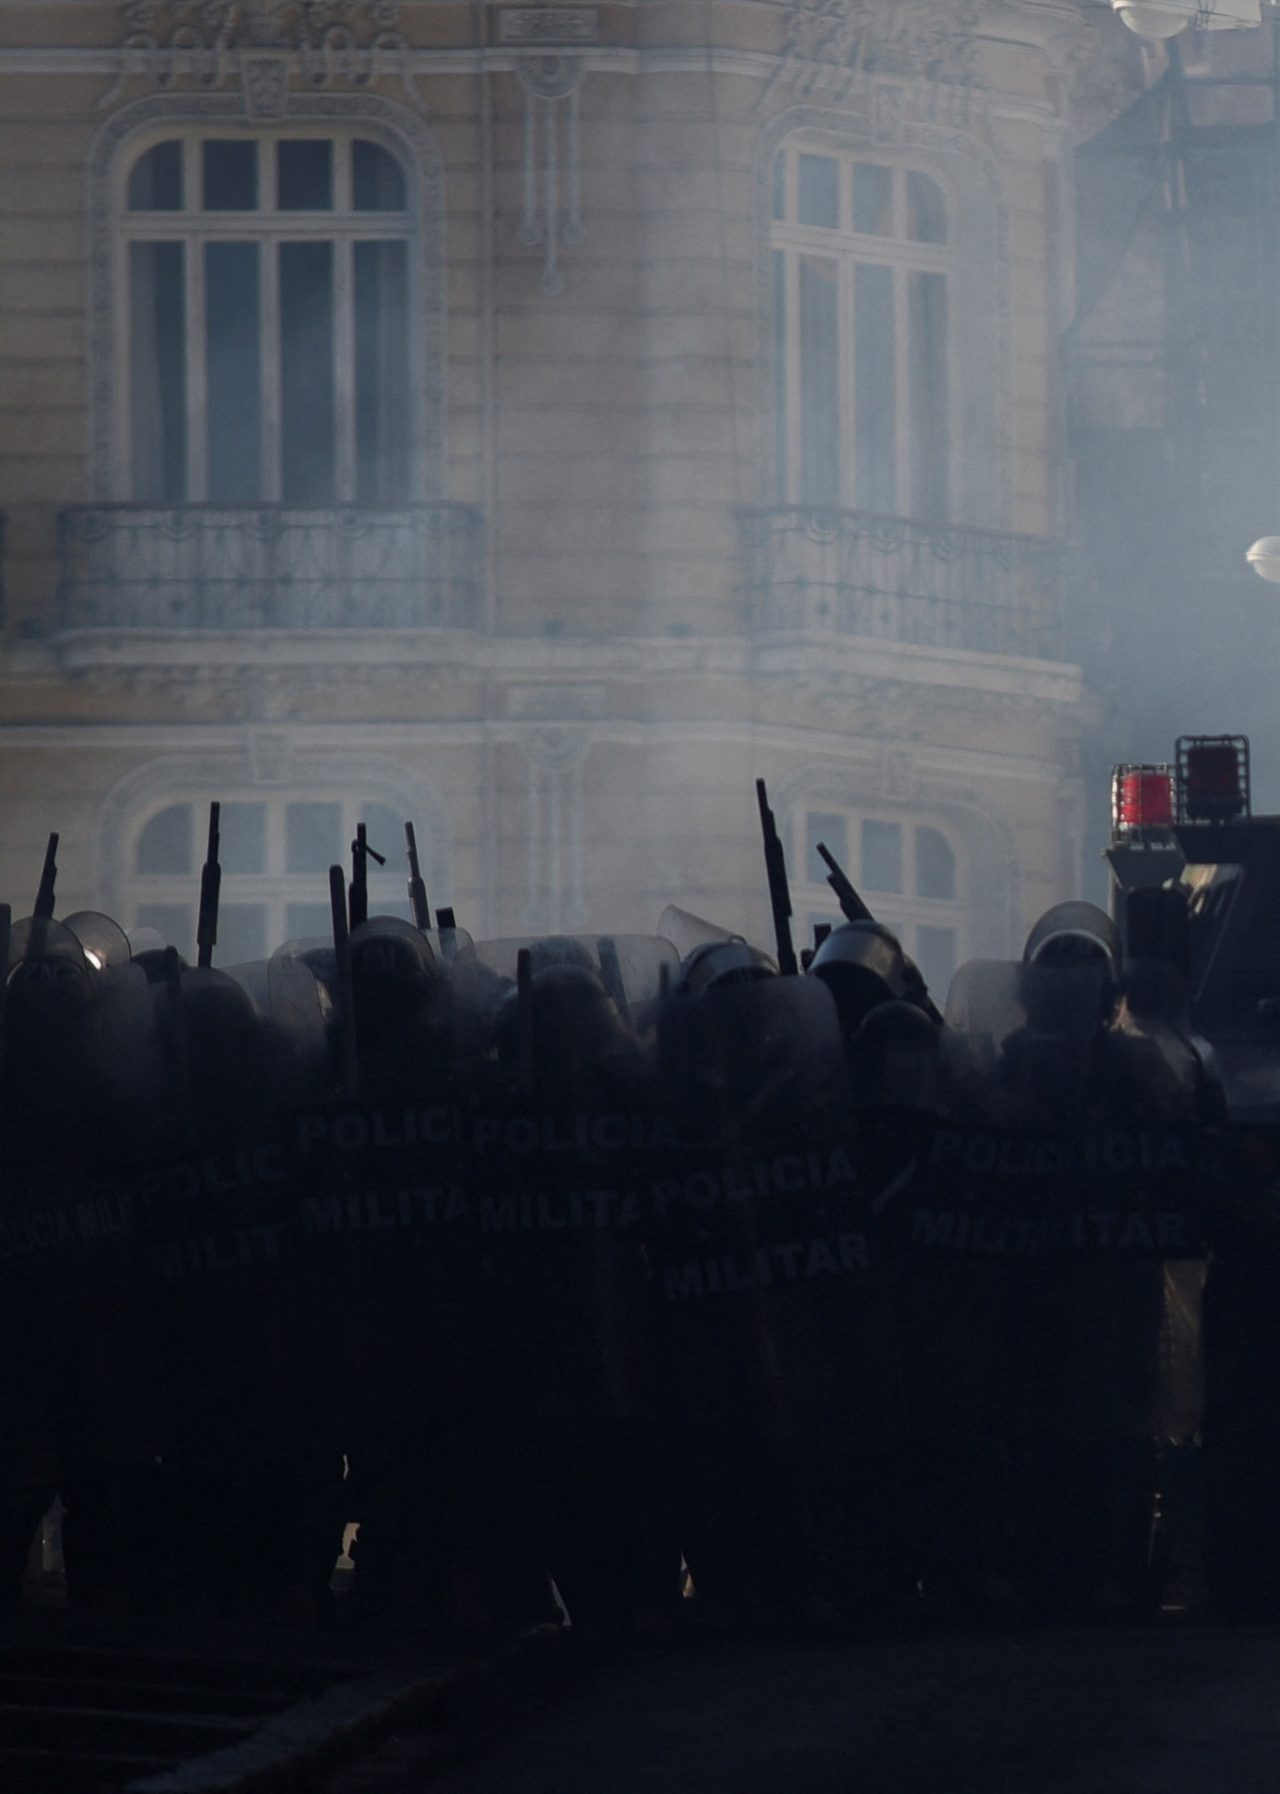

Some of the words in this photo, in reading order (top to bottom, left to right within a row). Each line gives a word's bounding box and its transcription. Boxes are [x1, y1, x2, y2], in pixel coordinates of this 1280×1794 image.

[470, 1112, 680, 1153] POLICIA
[651, 1148, 858, 1216] POLICIA
[663, 1232, 873, 1301] MILITAR
